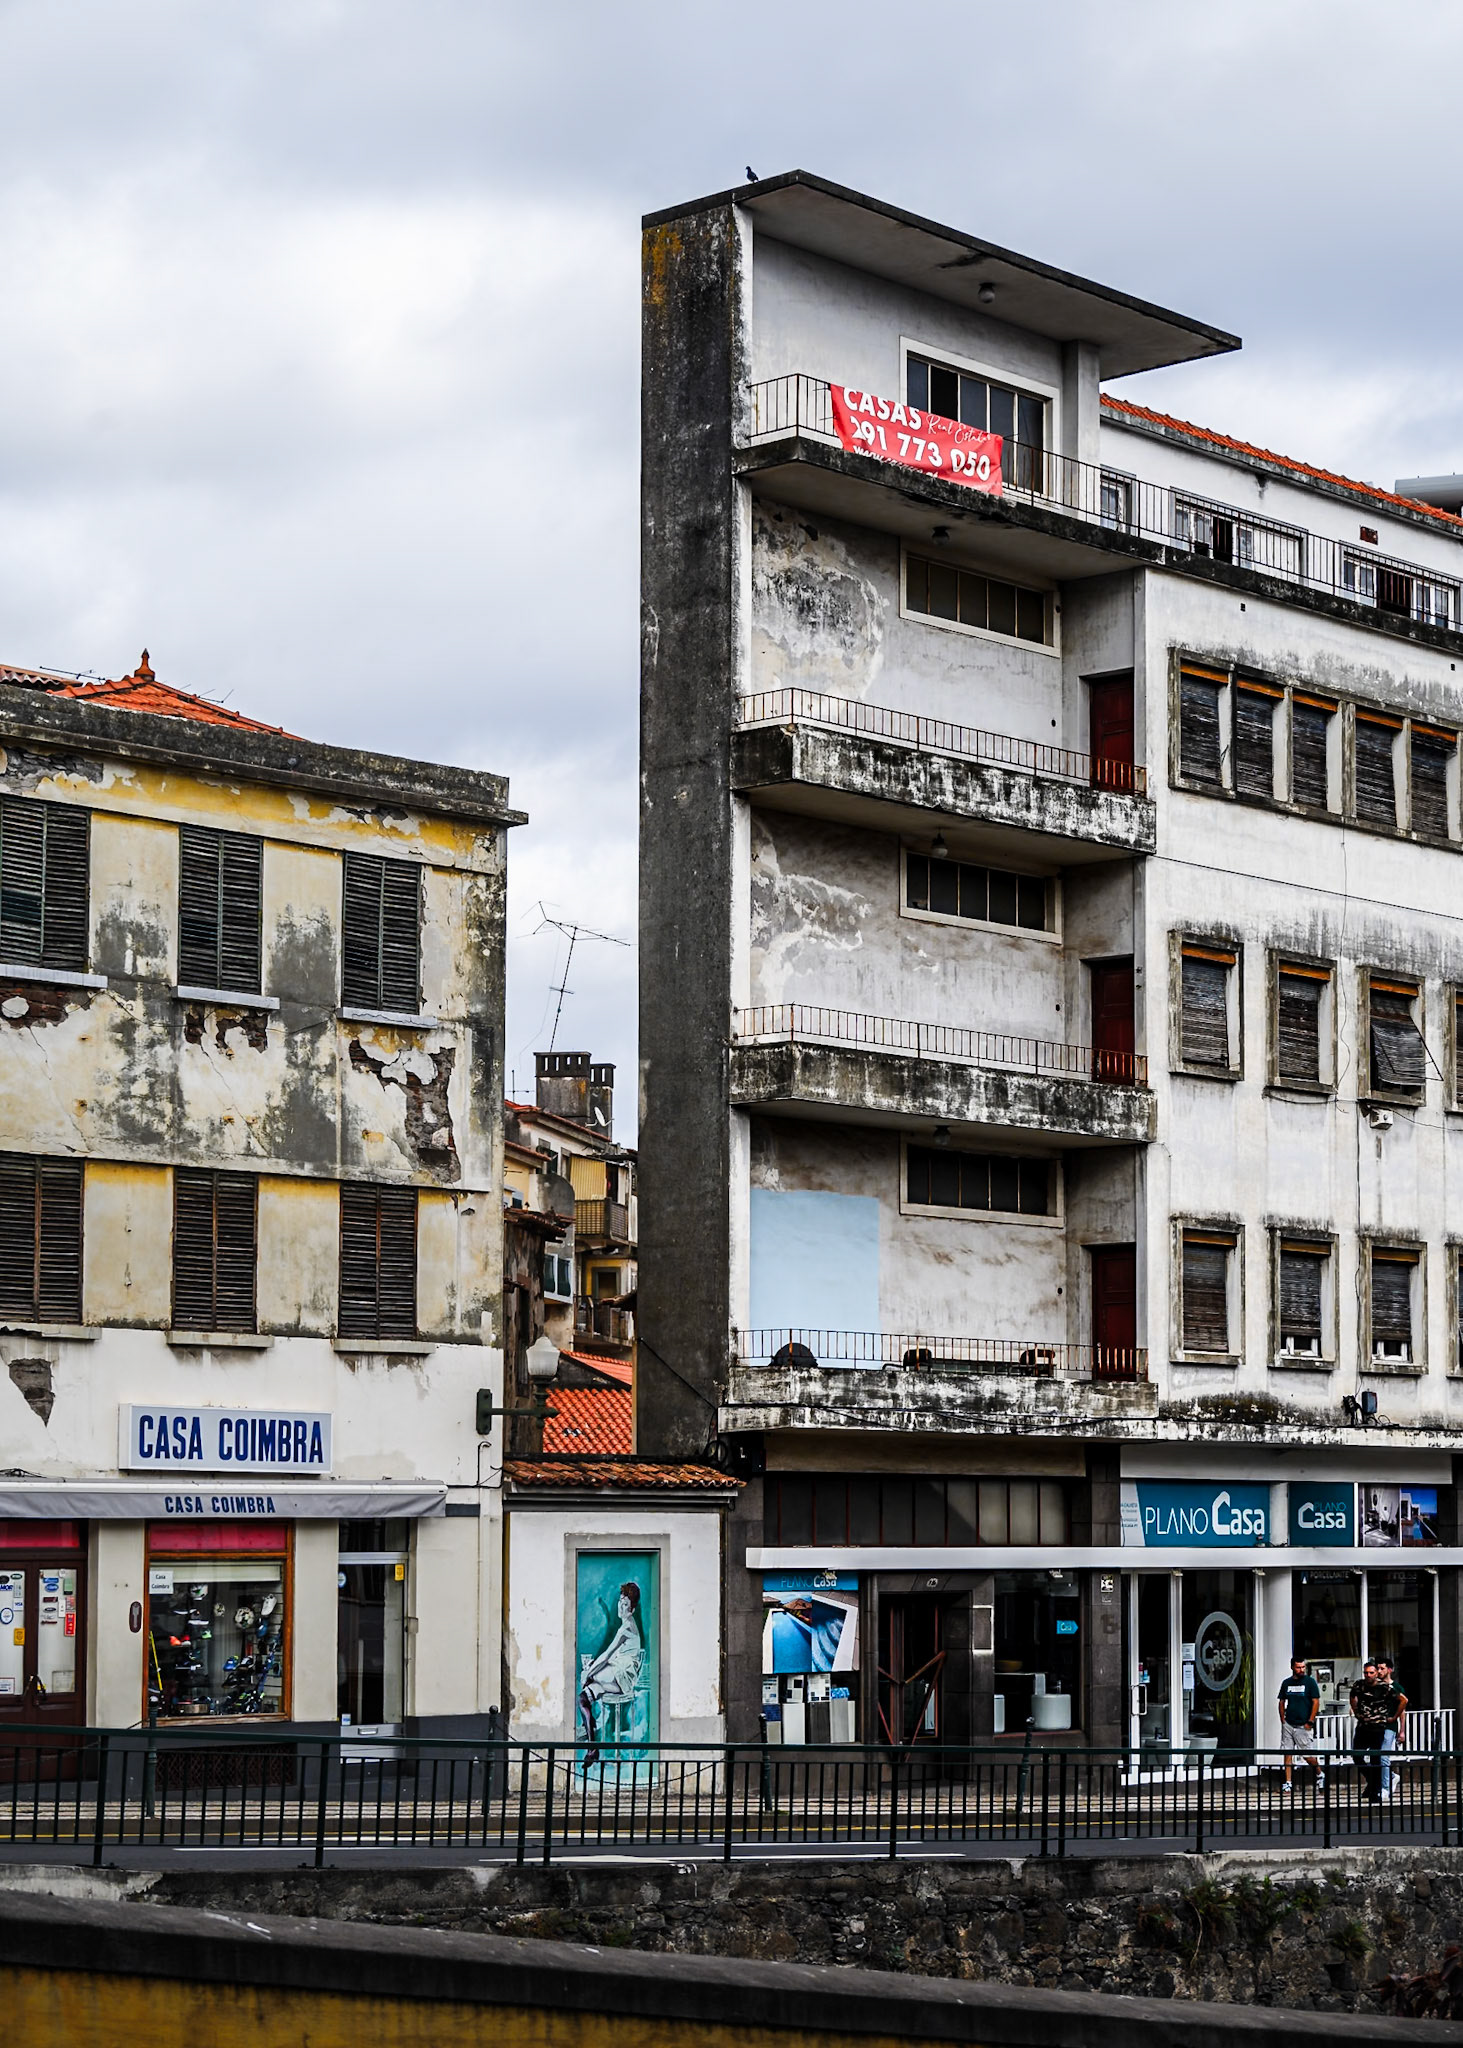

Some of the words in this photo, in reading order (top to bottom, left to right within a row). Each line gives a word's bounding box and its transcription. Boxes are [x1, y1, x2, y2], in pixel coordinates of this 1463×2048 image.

[843, 387, 922, 430] CASAS
[850, 416, 888, 451] 291
[897, 433, 943, 468] 773
[950, 449, 991, 482] 050
[139, 1415, 203, 1460] CASA
[218, 1418, 324, 1463] COIMBRA
[165, 1496, 204, 1513] CASA
[212, 1496, 275, 1514] COIMBRA
[1145, 1506, 1209, 1535] PLANO
[1212, 1490, 1265, 1536] Casa
[1297, 1501, 1346, 1529] Casa
[1314, 1502, 1346, 1512] PLANO
[813, 1575, 836, 1588] Casa
[1202, 1639, 1235, 1664] Casa
